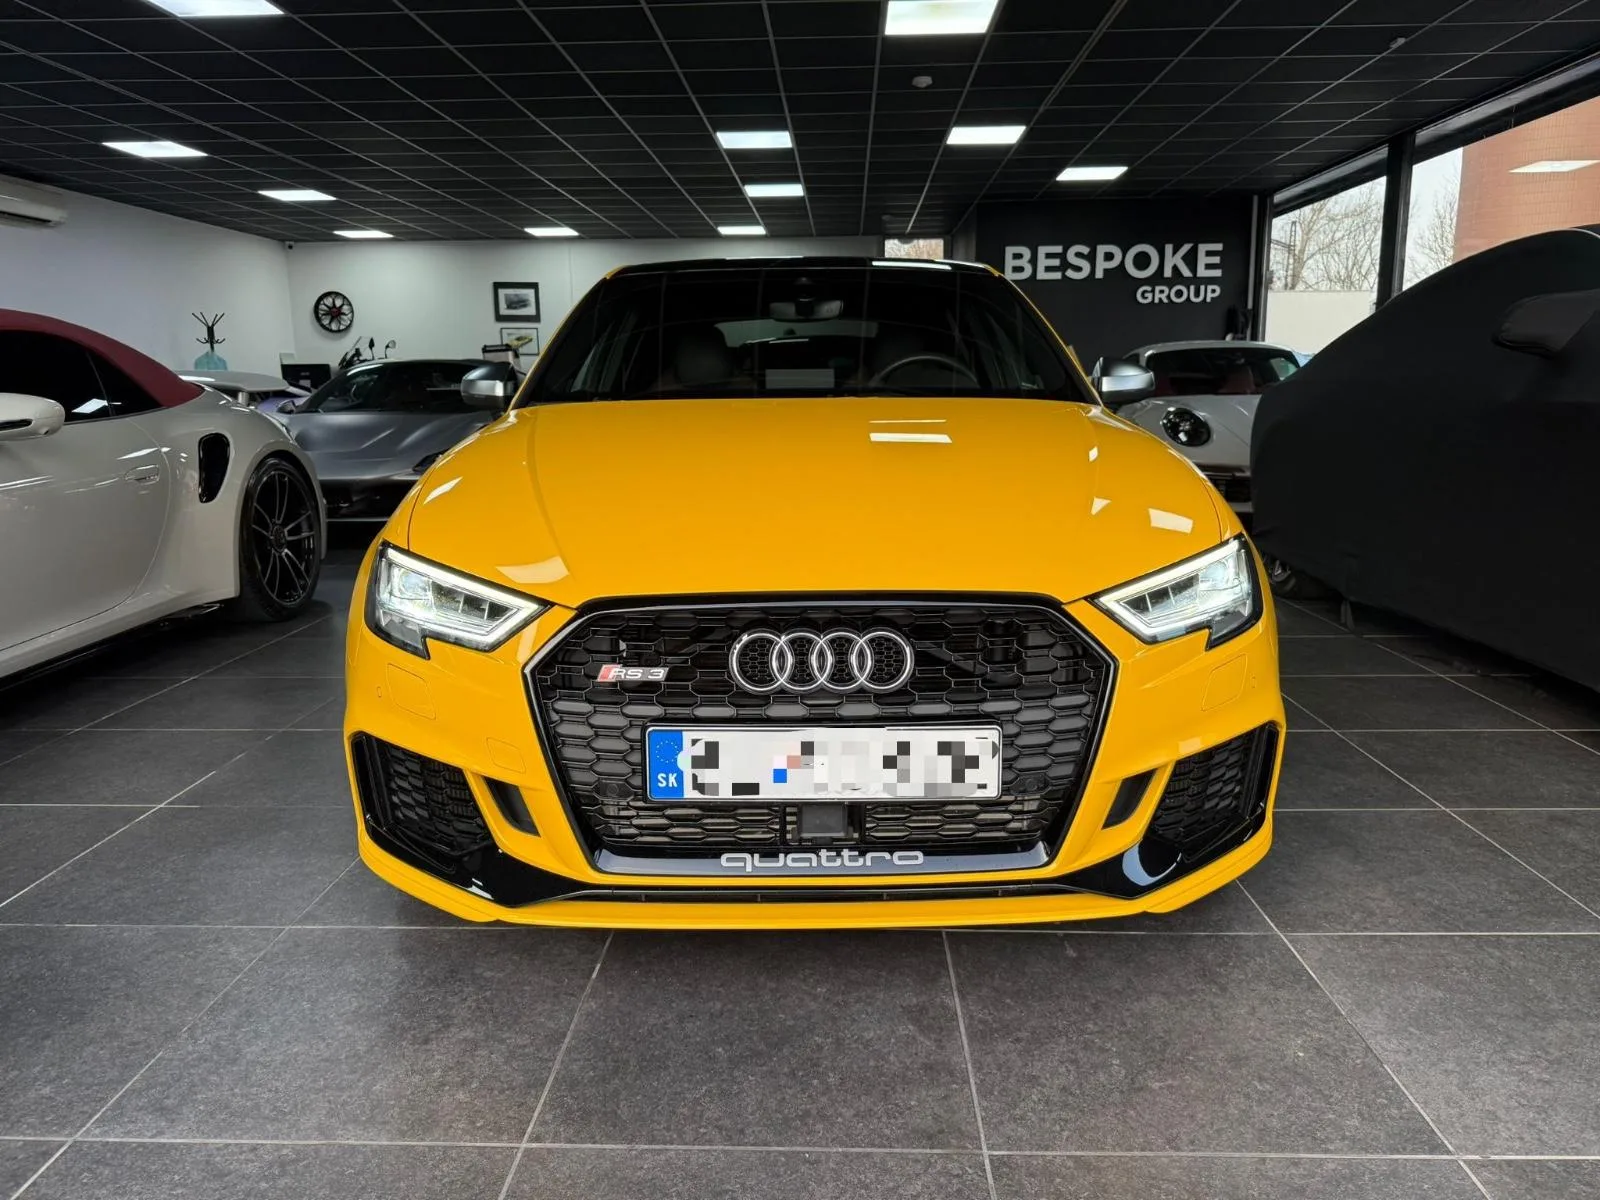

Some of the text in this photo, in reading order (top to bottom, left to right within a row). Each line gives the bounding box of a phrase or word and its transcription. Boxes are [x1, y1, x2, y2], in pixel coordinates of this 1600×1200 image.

[1004, 243, 1224, 281] BESPOKE
[1136, 285, 1221, 304] GROUP
[607, 667, 665, 679] RS 3
[657, 773, 678, 788] SK
[720, 848, 924, 873] quattro
